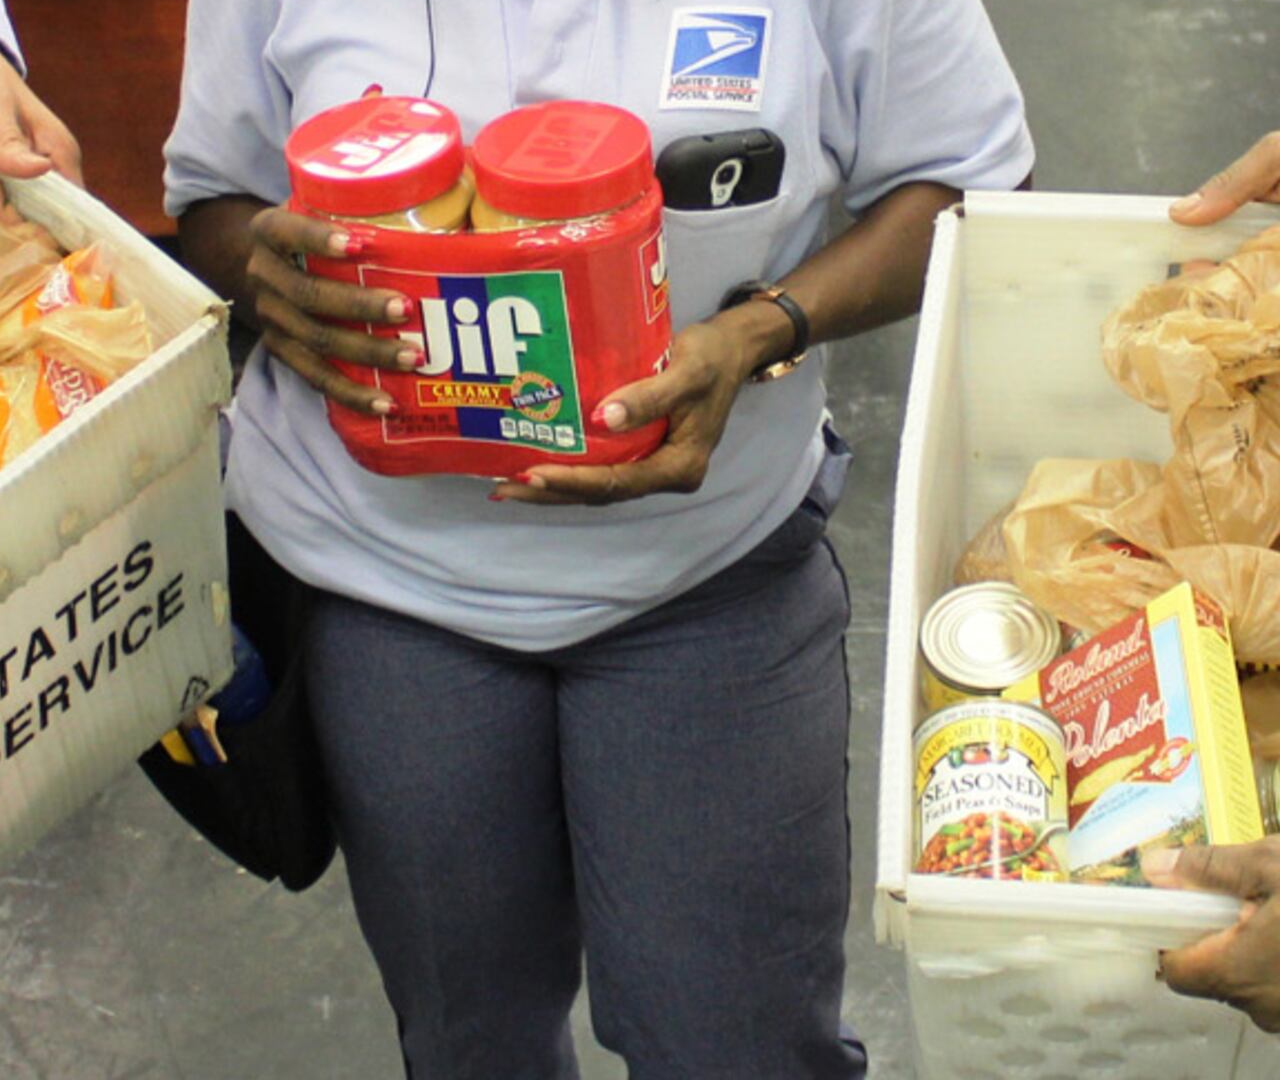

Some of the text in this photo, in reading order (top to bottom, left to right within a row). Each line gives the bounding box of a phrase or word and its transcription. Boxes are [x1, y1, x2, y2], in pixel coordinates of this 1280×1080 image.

[331, 110, 425, 168] Jif
[399, 295, 542, 376] Jif
[432, 384, 502, 399] CREAMY
[1046, 618, 1145, 702] Roland
[1065, 692, 1166, 767] Polenta
[924, 773, 1043, 807] SEASONED
[926, 803, 952, 824] Field
[956, 796, 985, 810] Peas
[1005, 795, 1041, 815] Snaps
